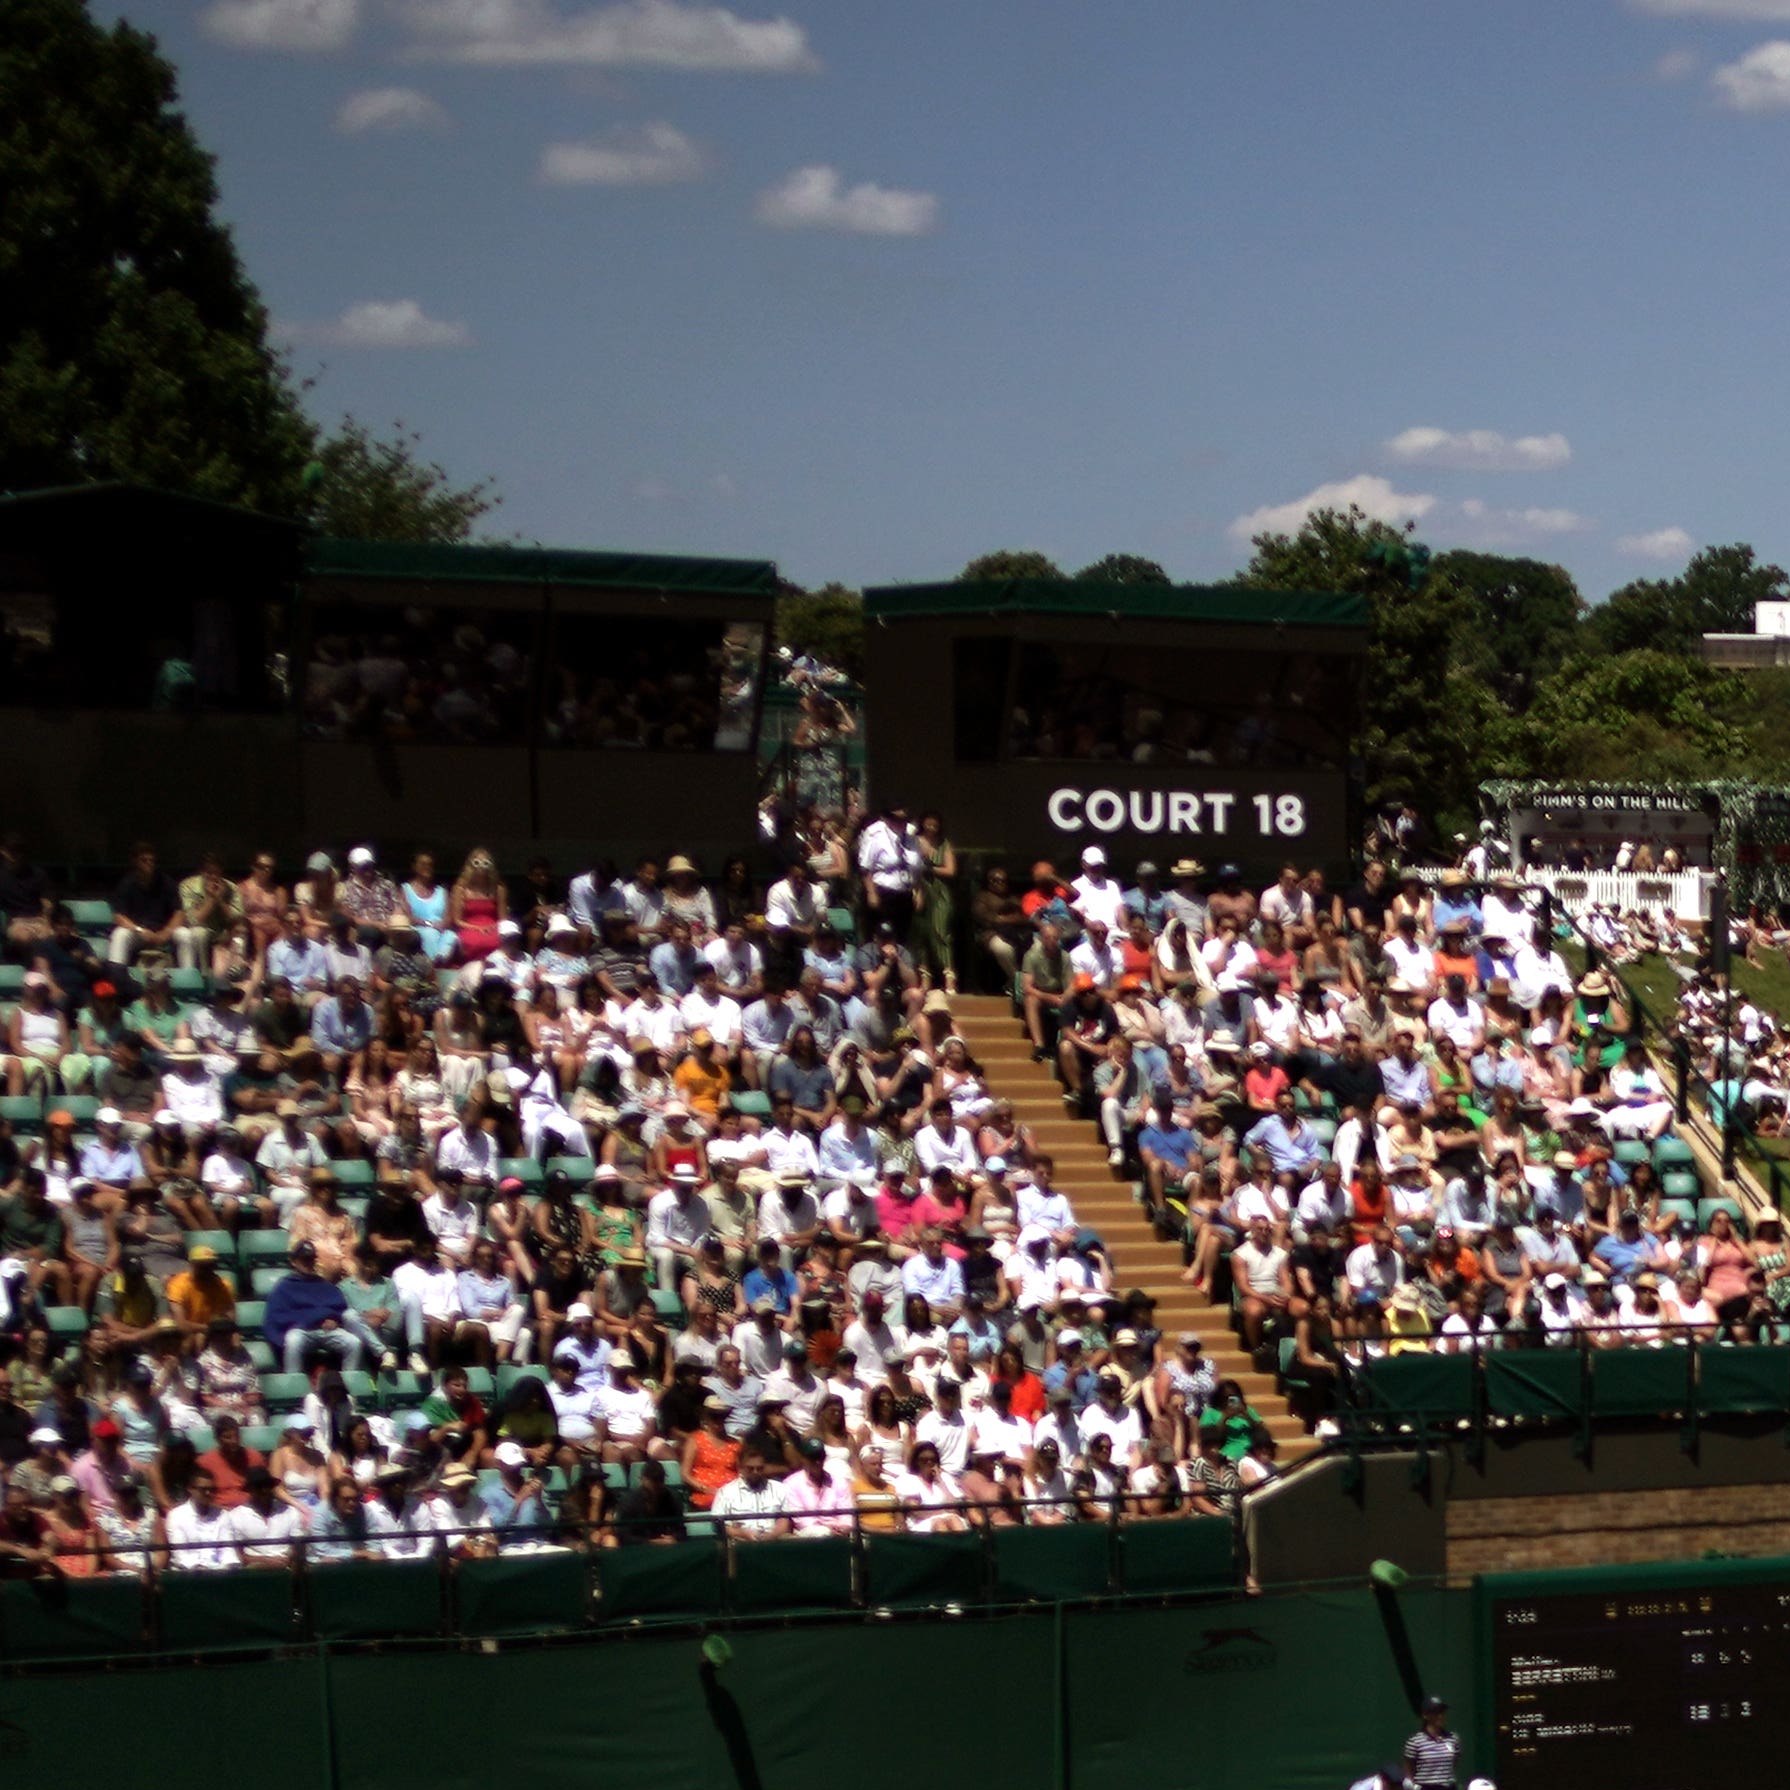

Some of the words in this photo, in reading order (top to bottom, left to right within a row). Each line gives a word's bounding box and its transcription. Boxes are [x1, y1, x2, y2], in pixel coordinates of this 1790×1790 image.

[1046, 787, 1236, 834] COURT
[1252, 793, 1307, 837] 18
[1532, 794, 1588, 809] PIMM'S
[1592, 795, 1616, 809] ON
[1620, 796, 1652, 809] THE
